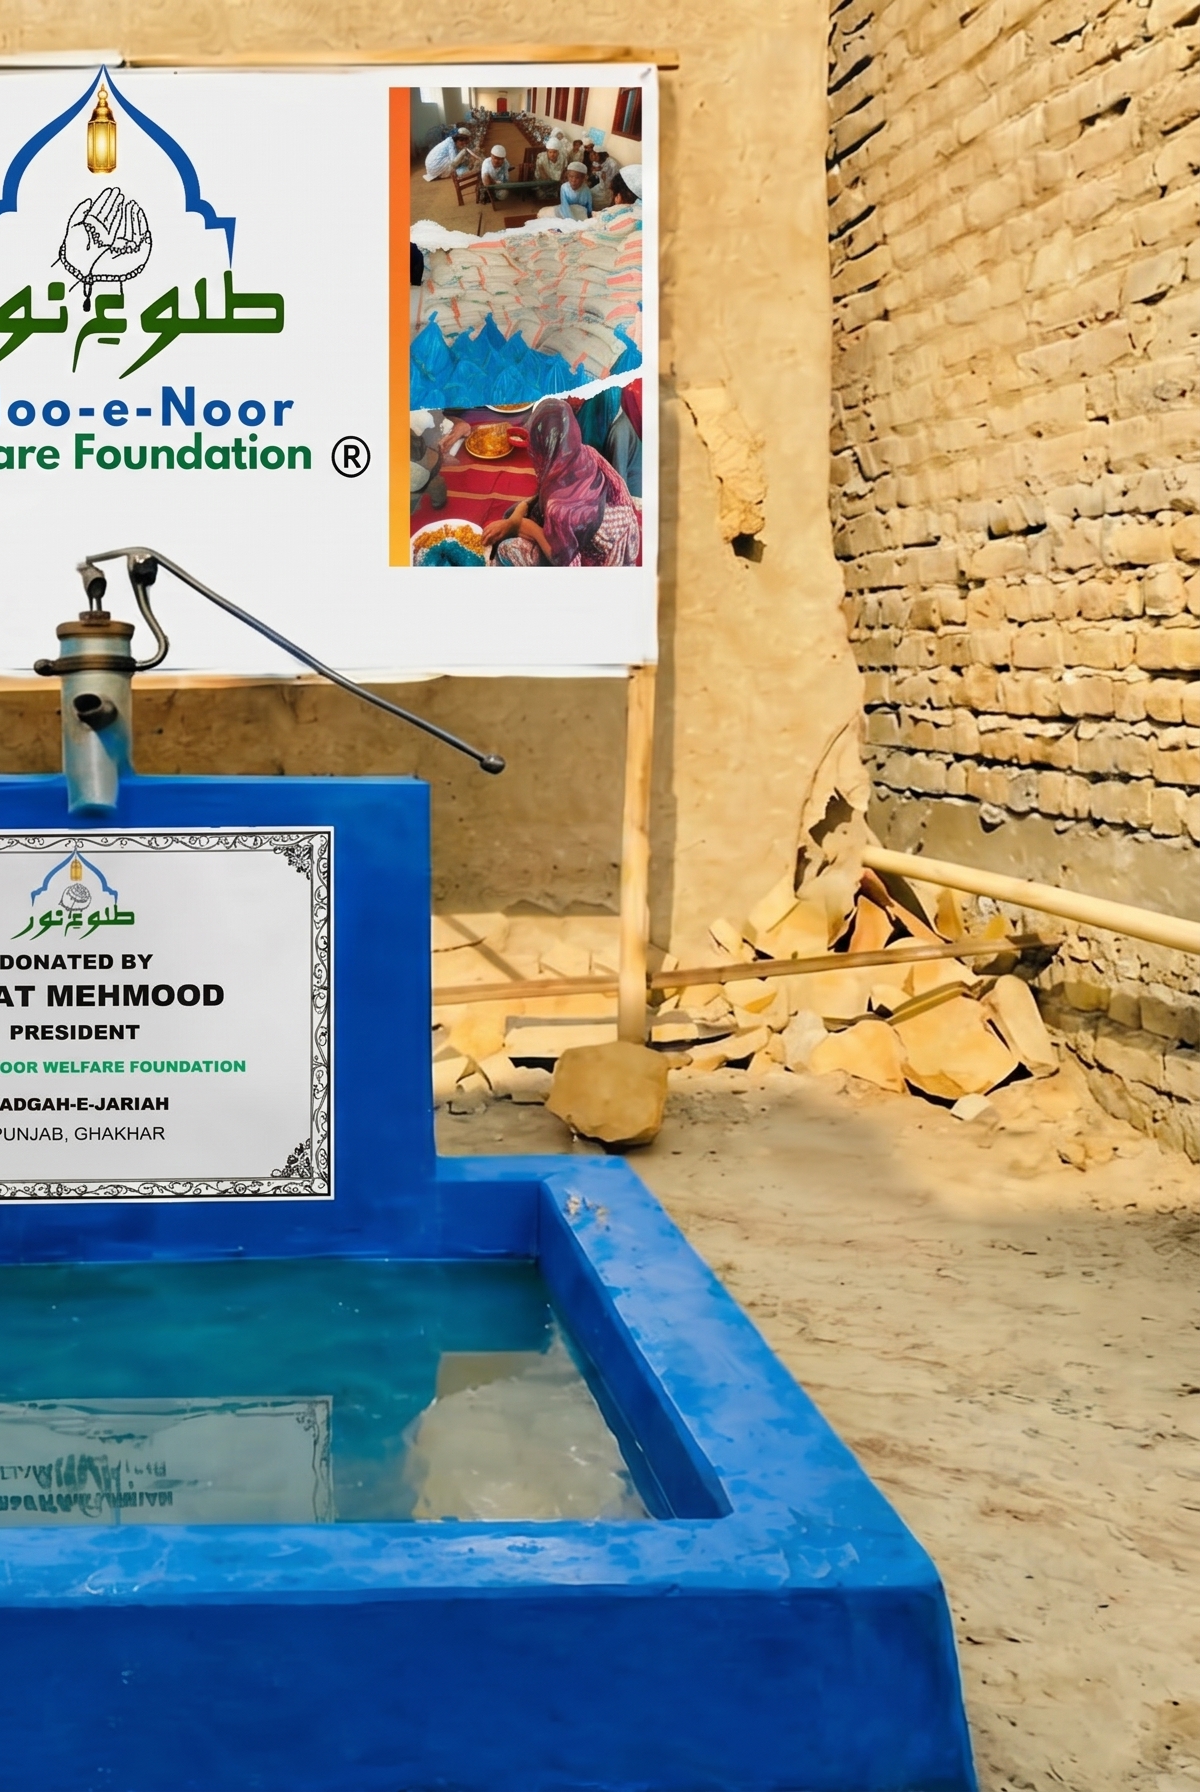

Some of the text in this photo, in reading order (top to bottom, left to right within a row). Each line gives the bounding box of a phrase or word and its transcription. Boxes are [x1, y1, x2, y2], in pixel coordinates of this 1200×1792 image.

[74, 431, 312, 470] Foundation
[0, 953, 154, 971] DONATED BY
[47, 983, 225, 1007] MEHMOOD
[10, 1024, 141, 1041] PRESIDENT
[43, 1060, 125, 1074] WELFARE
[129, 1060, 246, 1074] FOUNDATION
[74, 1126, 165, 1141] GHAKHAR
